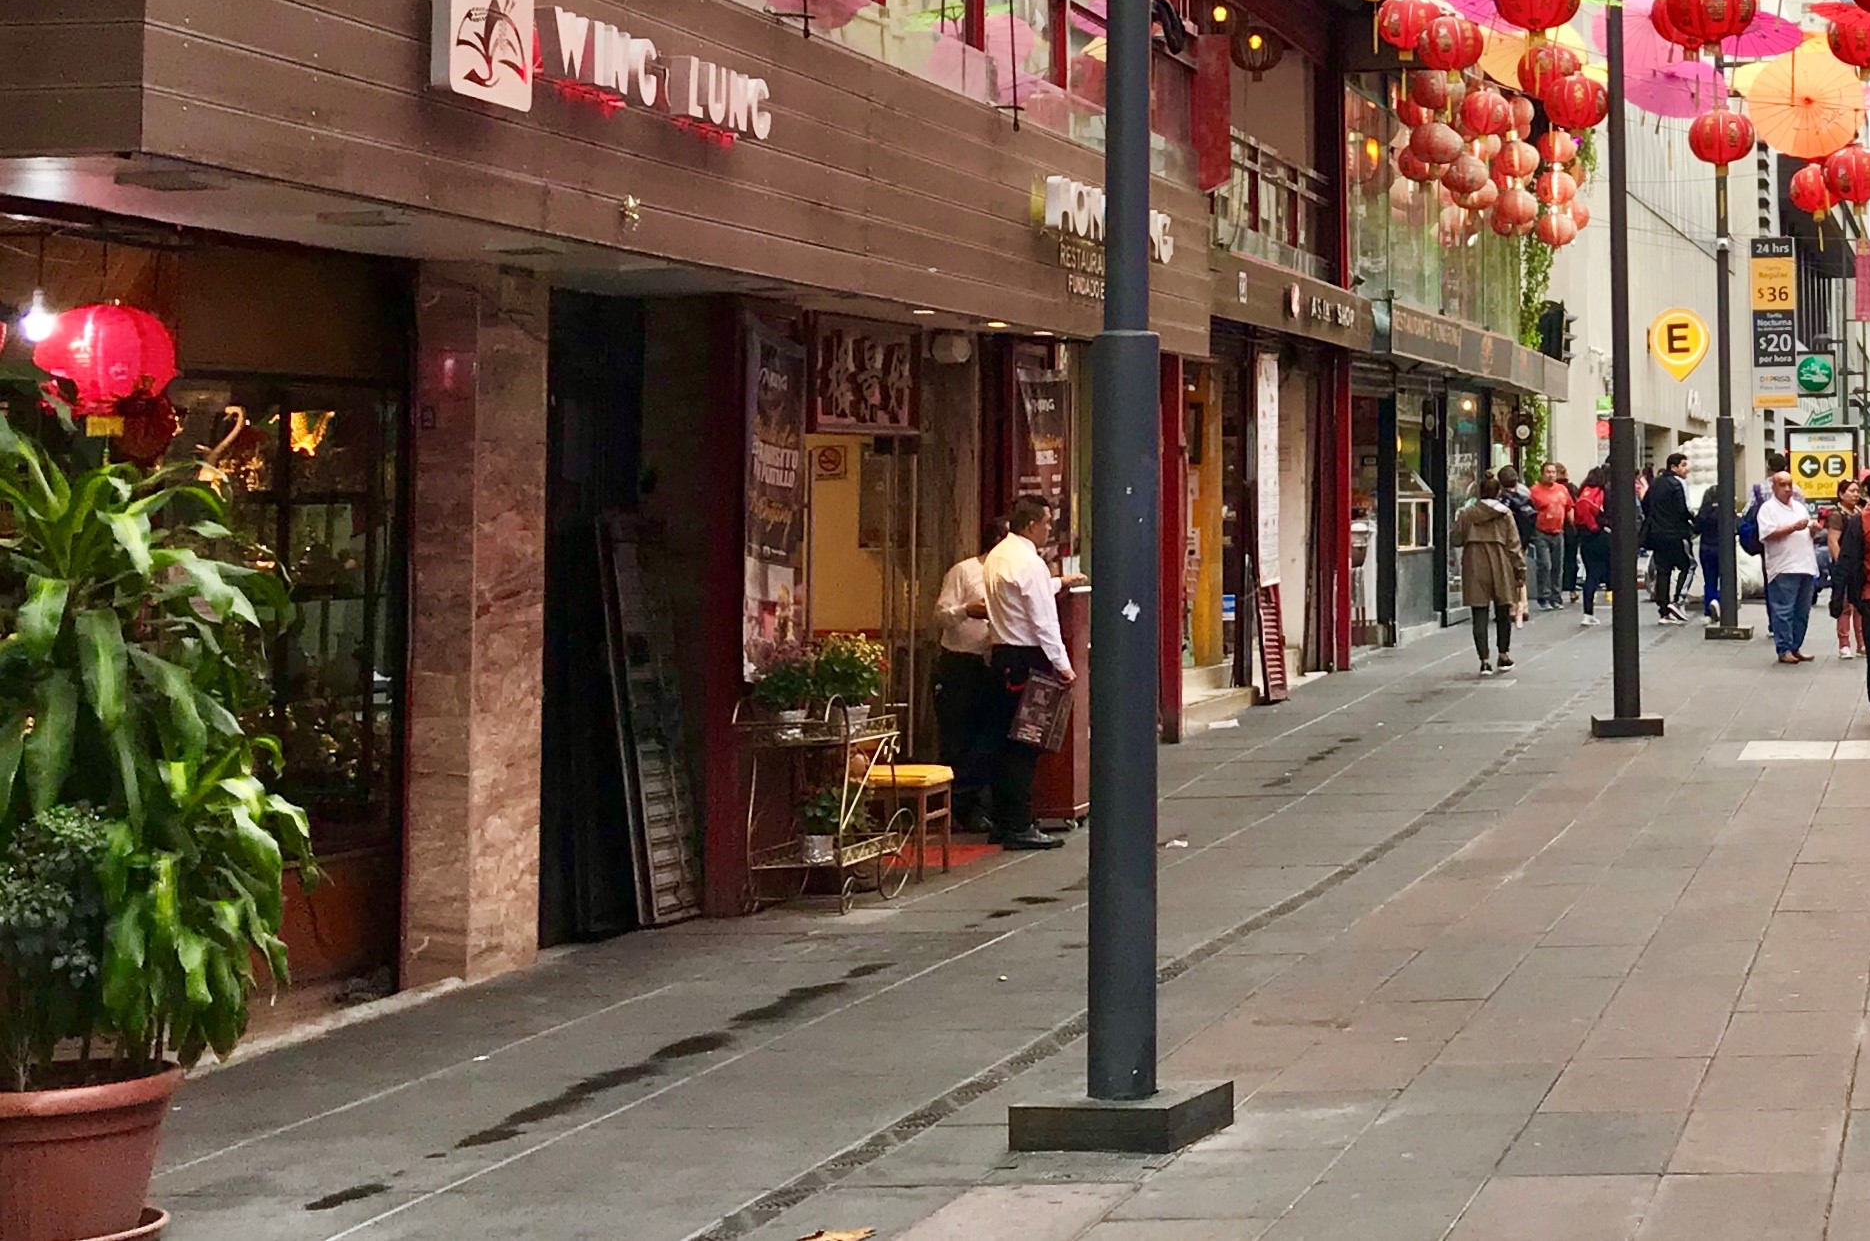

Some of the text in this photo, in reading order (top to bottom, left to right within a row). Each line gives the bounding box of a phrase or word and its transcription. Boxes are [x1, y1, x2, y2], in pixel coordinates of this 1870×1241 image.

[554, 6, 773, 140] WING LUNG
[1756, 242, 1790, 254] 24 hrs
[1757, 318, 1793, 328] Nocturna
[1667, 323, 1690, 354] E
[1759, 333, 1793, 352] $20
[1759, 353, 1793, 365] por hora
[1827, 458, 1842, 476] E
